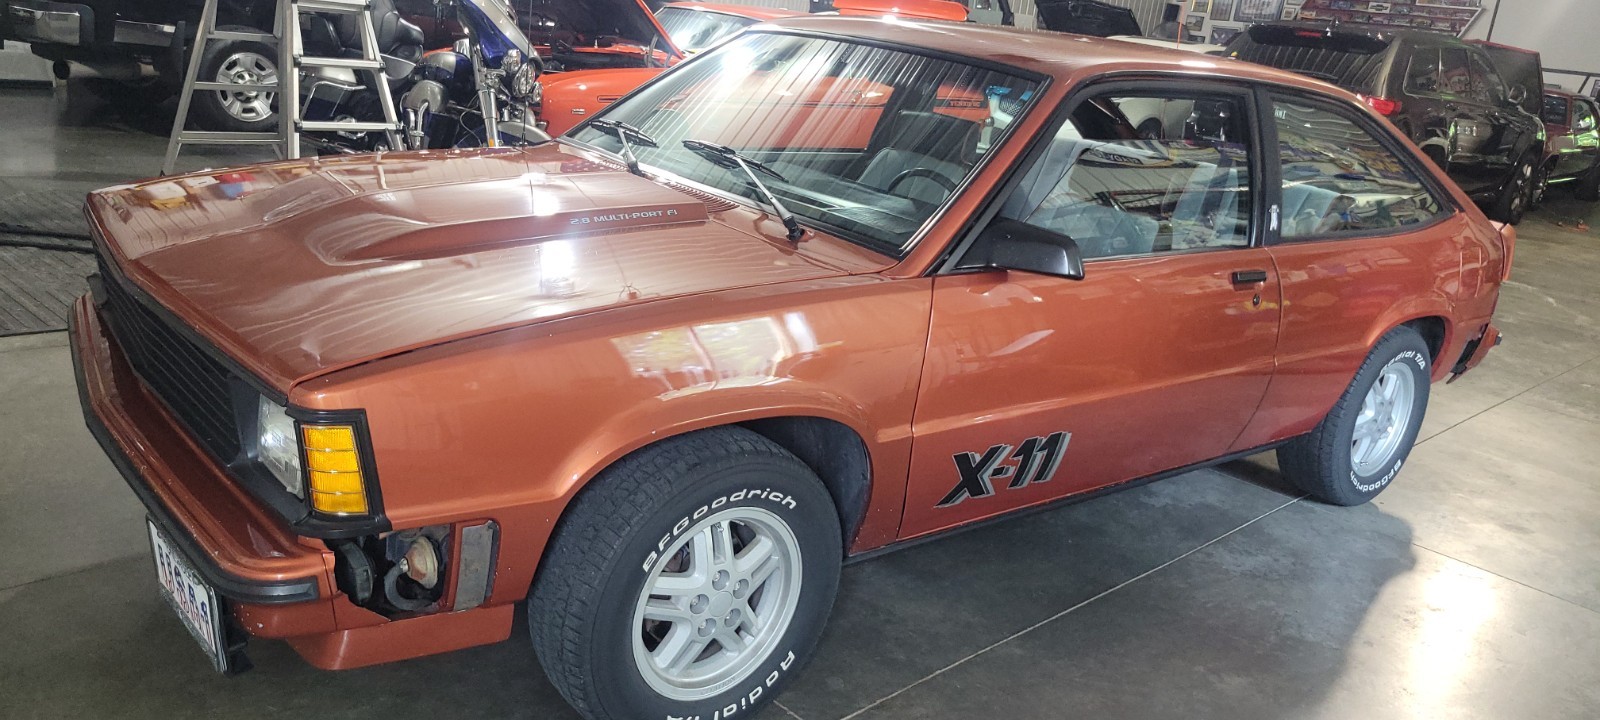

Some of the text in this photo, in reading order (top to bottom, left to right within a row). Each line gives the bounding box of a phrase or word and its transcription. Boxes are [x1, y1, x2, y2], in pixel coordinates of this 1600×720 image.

[570, 208, 678, 225] 2.8 MULTI-PORT FI
[933, 431, 1072, 508] X-11
[1350, 459, 1402, 493] BFGoodrich
[642, 488, 797, 573] BFGoodrich
[713, 650, 796, 720] Radial
